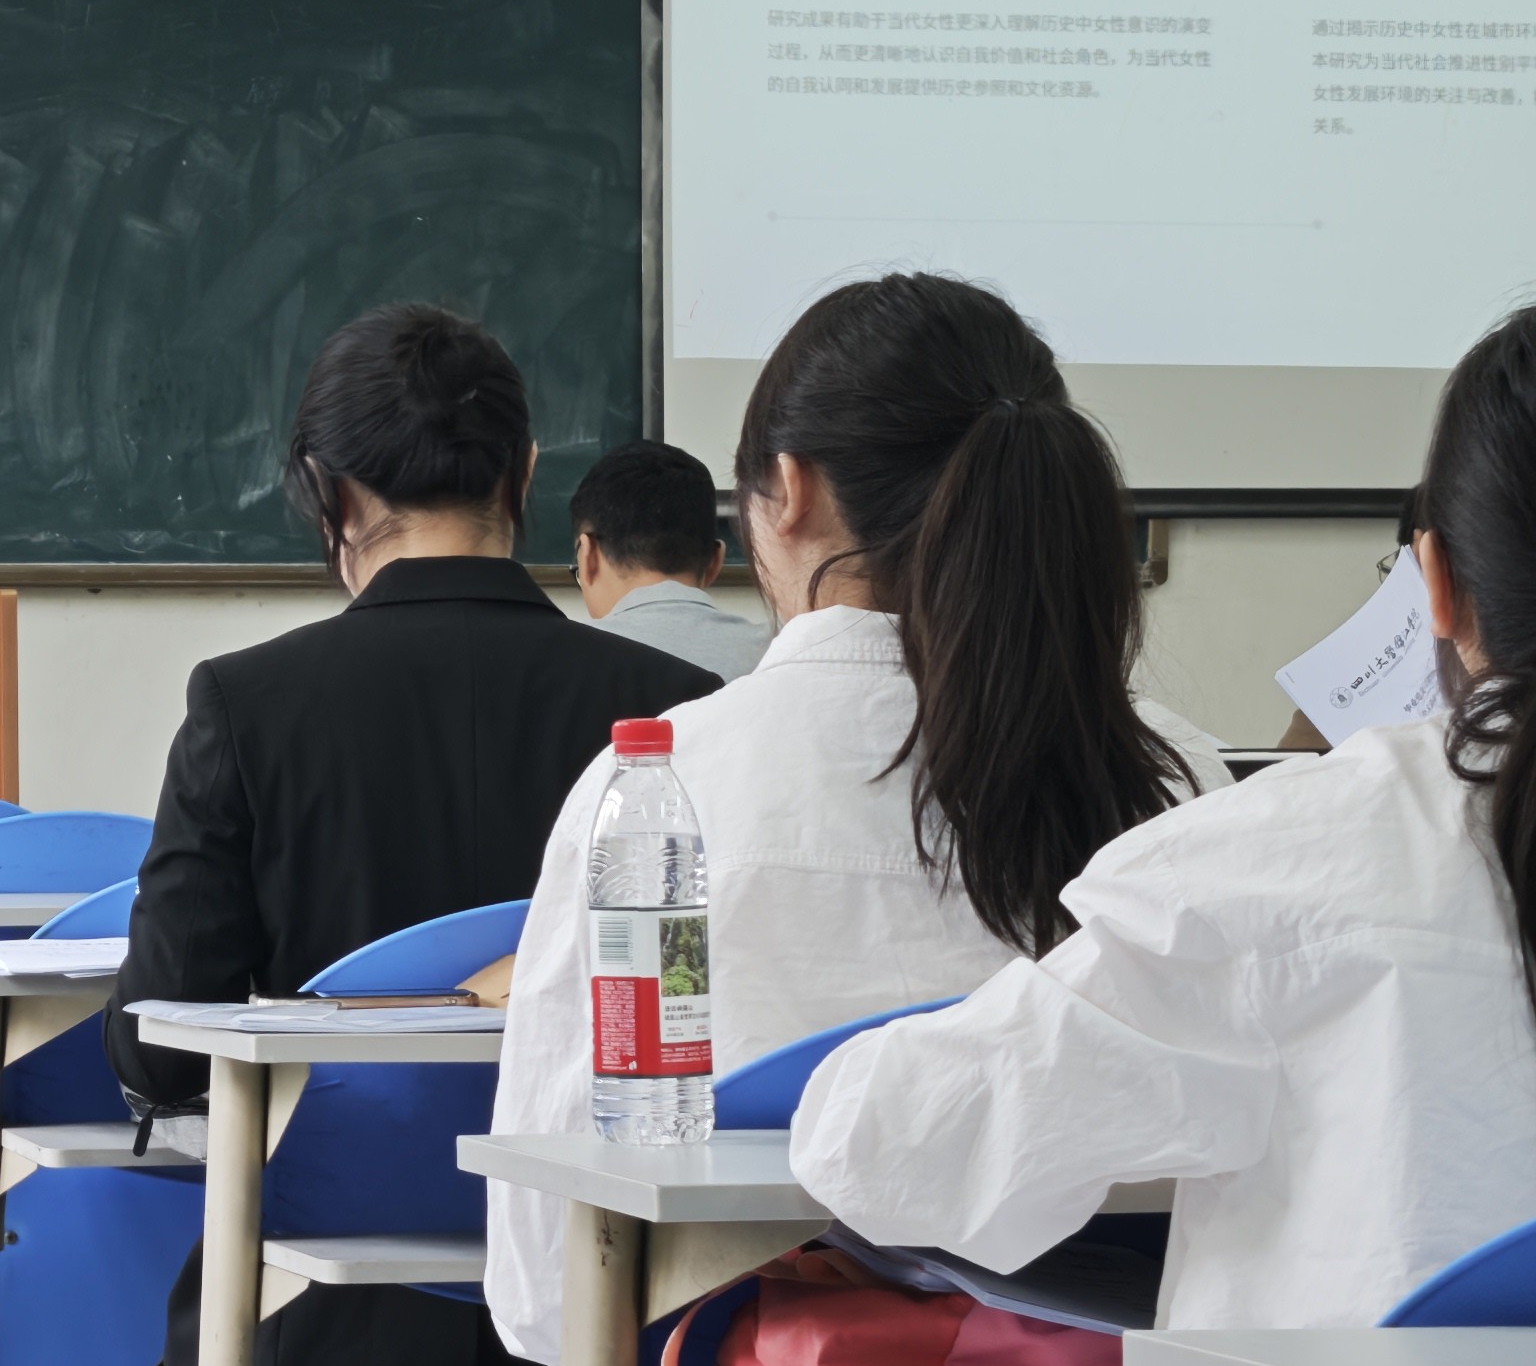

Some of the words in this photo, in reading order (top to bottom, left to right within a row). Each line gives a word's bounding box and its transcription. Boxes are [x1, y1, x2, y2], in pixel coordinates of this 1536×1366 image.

[1312, 19, 1536, 39] 通过揭示历史中女性在城市环
[1312, 52, 1536, 73] 本研究为当代社会推进性别平
[1313, 85, 1536, 106] 女性发展环境的关注与改善，
